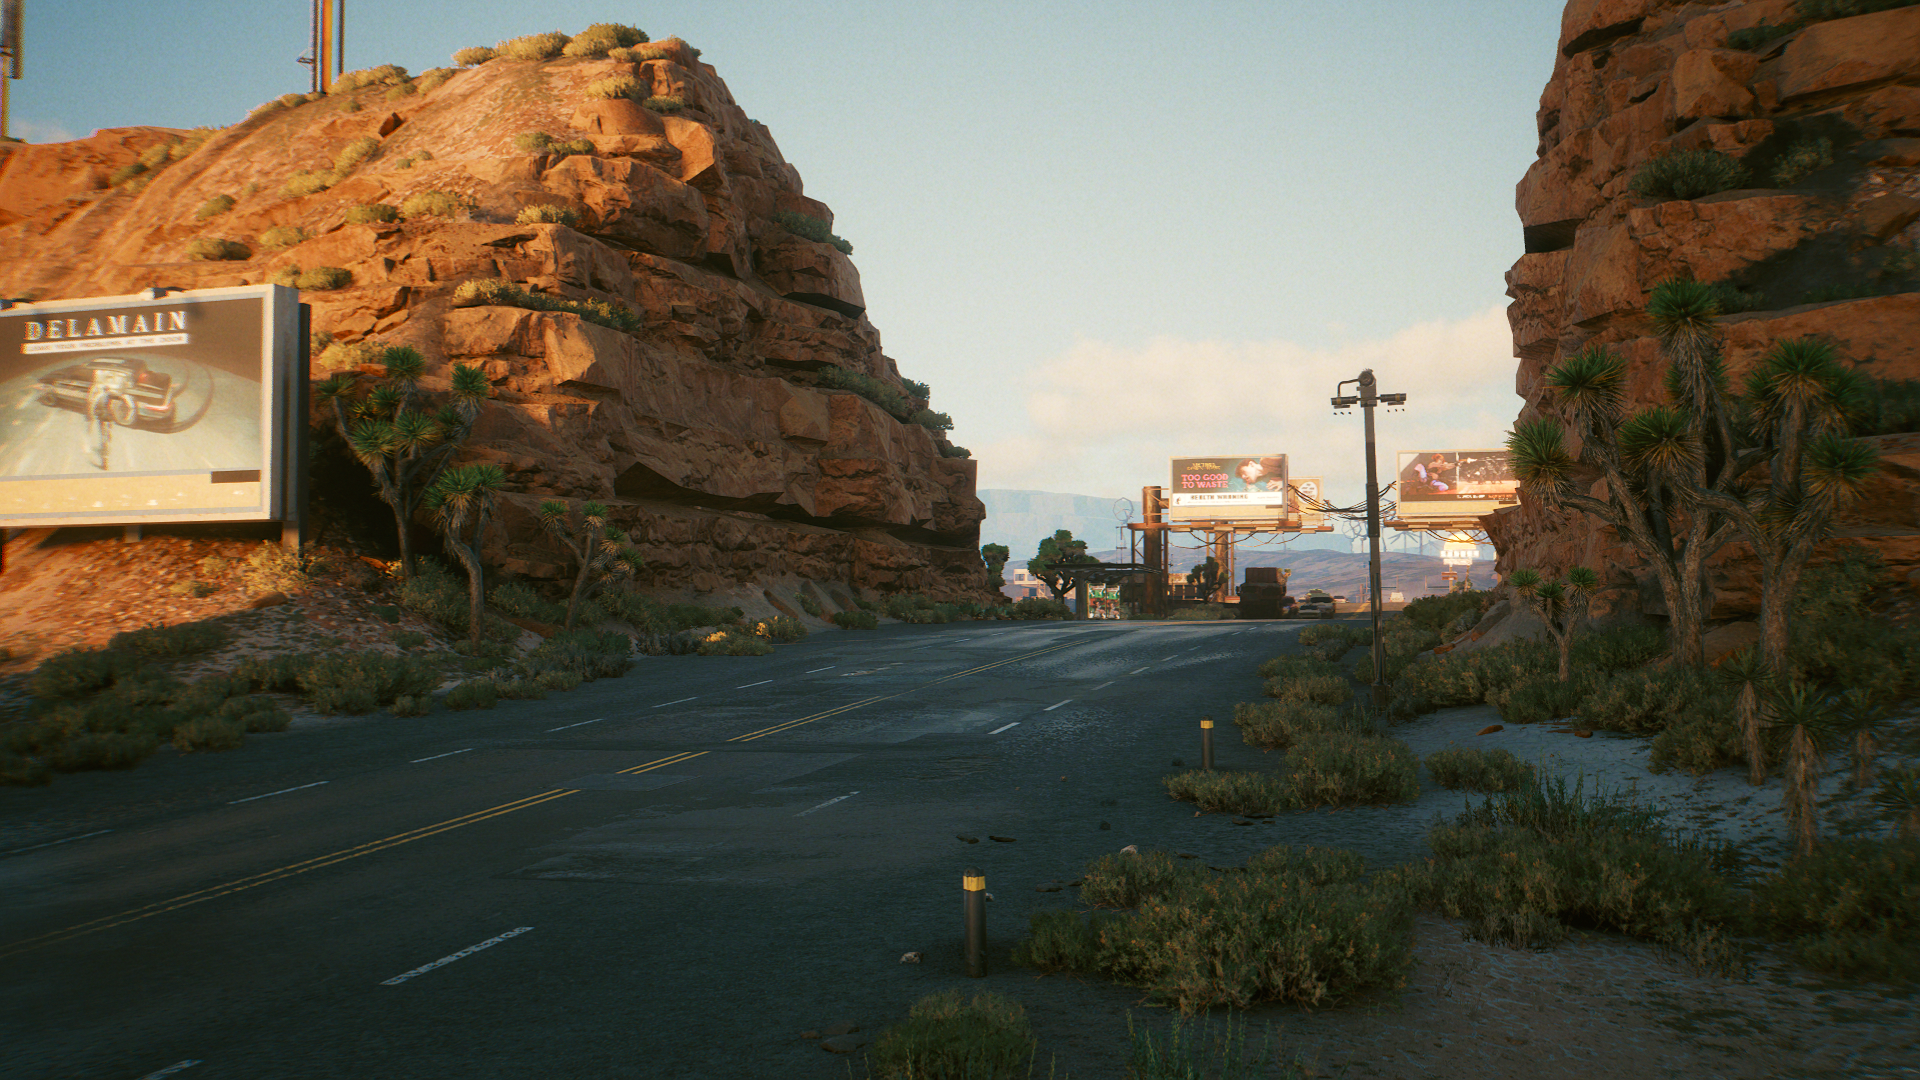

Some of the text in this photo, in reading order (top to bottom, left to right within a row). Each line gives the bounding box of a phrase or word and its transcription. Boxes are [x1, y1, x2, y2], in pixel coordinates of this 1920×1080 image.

[24, 311, 187, 341] DELAMAIN
[1202, 473, 1229, 481] GOOD
[1181, 481, 1195, 489] TO
